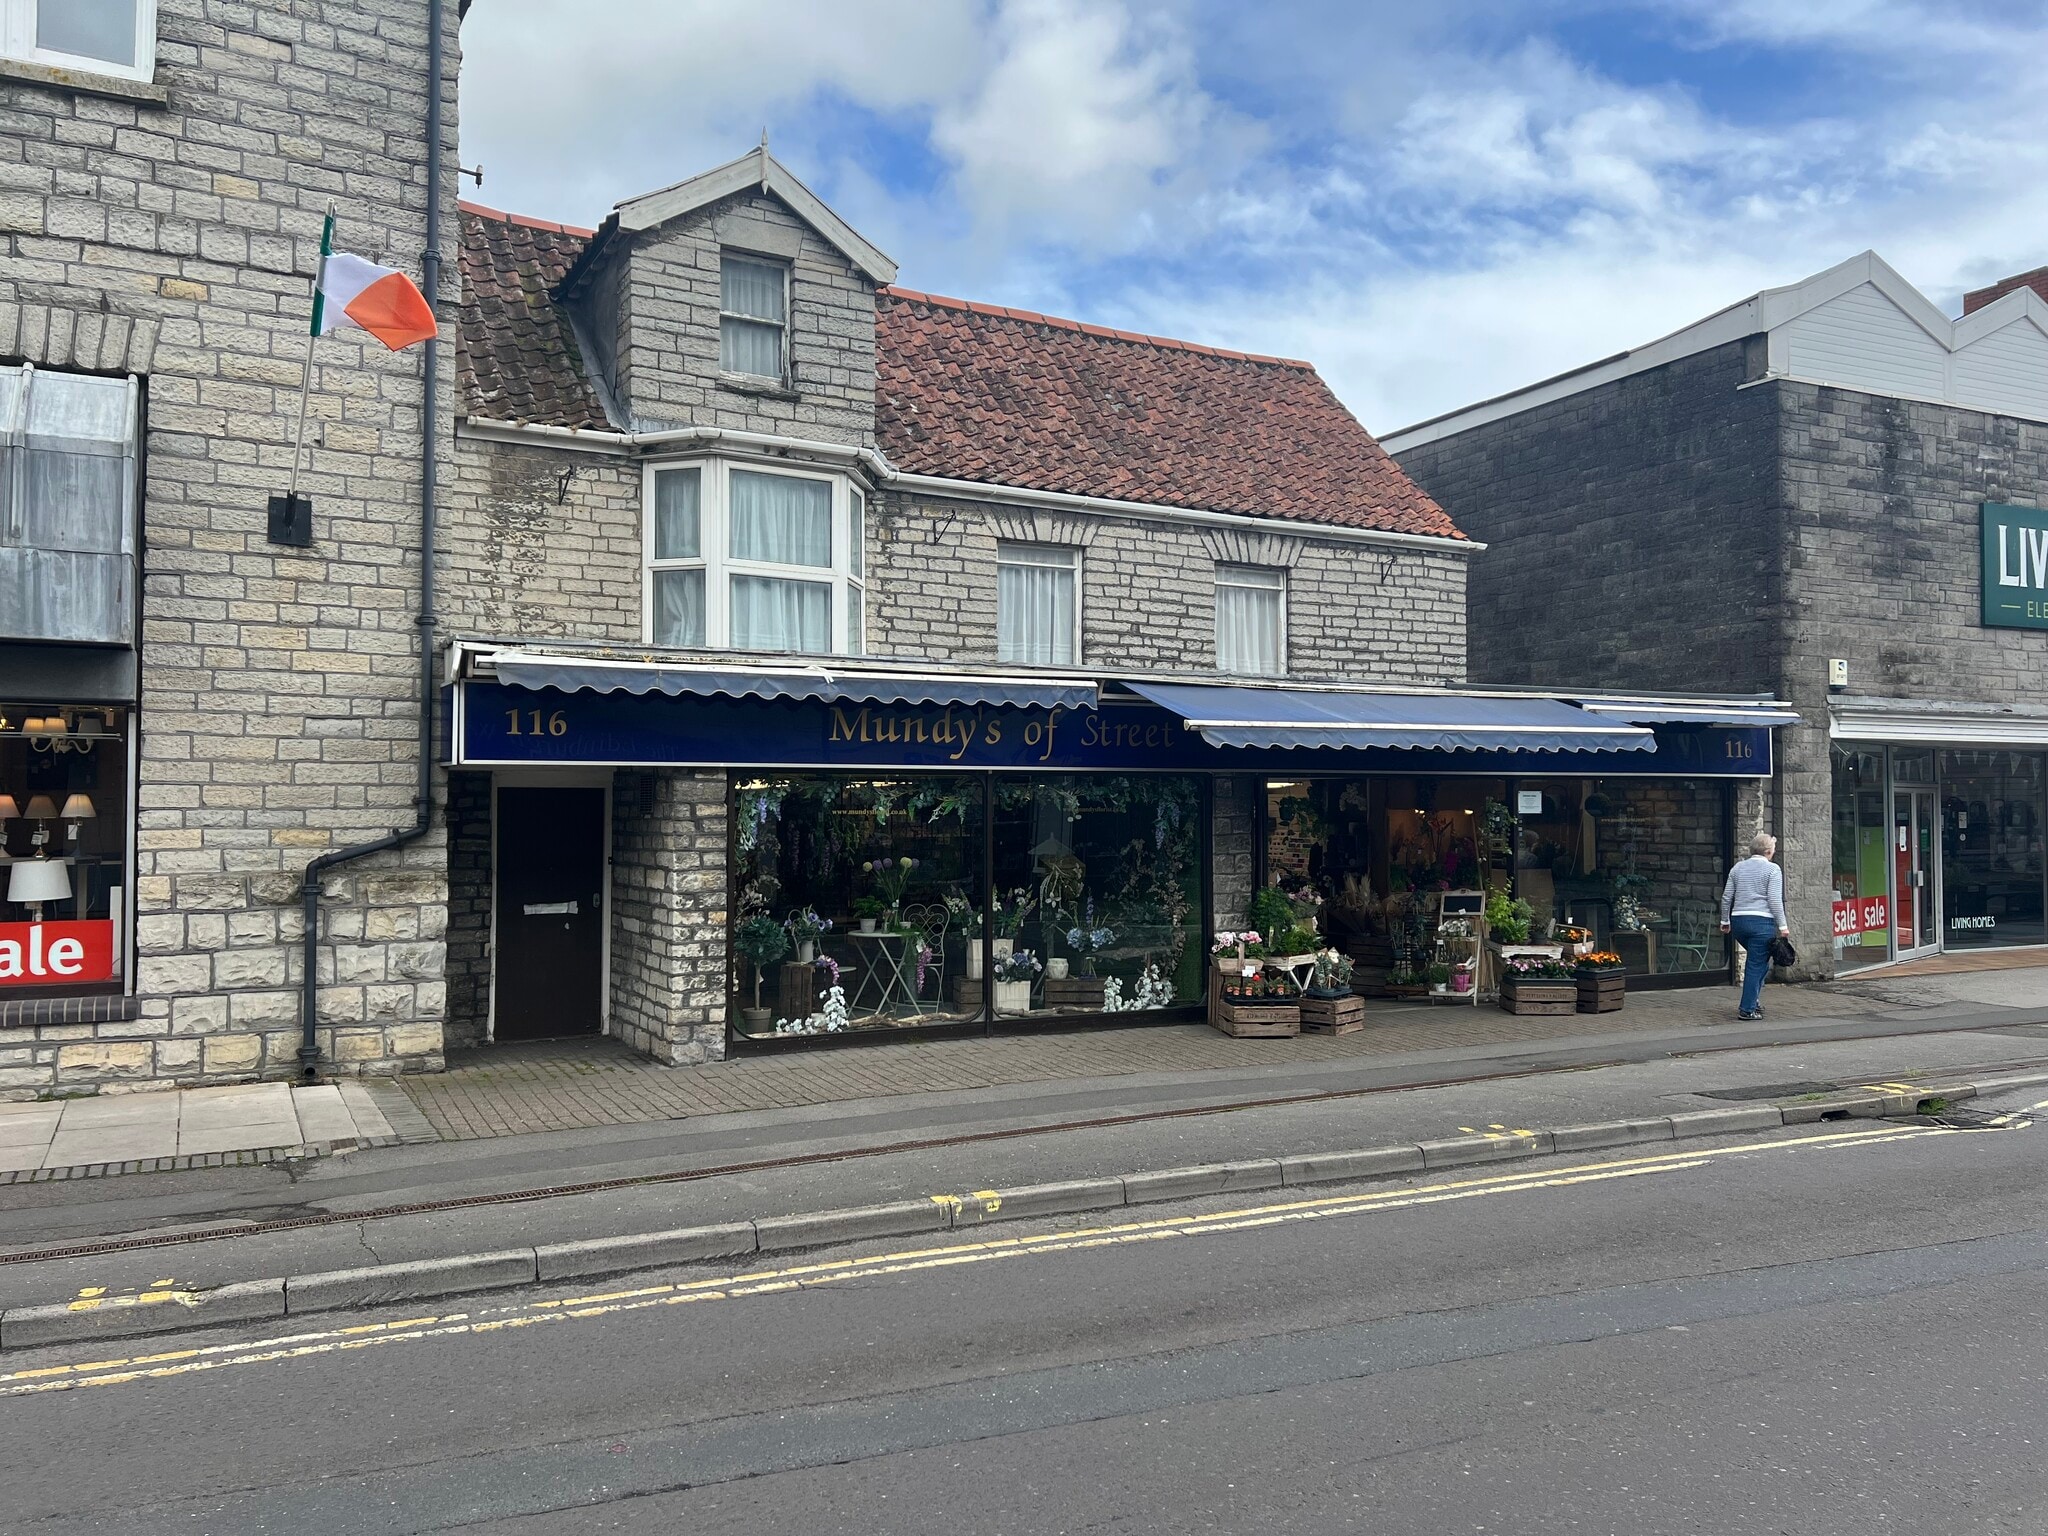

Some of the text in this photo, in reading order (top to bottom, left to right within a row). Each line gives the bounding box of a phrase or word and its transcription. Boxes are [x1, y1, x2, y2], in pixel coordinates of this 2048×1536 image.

[1998, 525, 2048, 589] LIV
[505, 708, 568, 737] 116
[828, 706, 1176, 761] Mundy's of Street
[1724, 740, 1753, 759] 116
[1834, 898, 1885, 932] sale sale
[1951, 915, 1996, 930] LIVING HOMES
